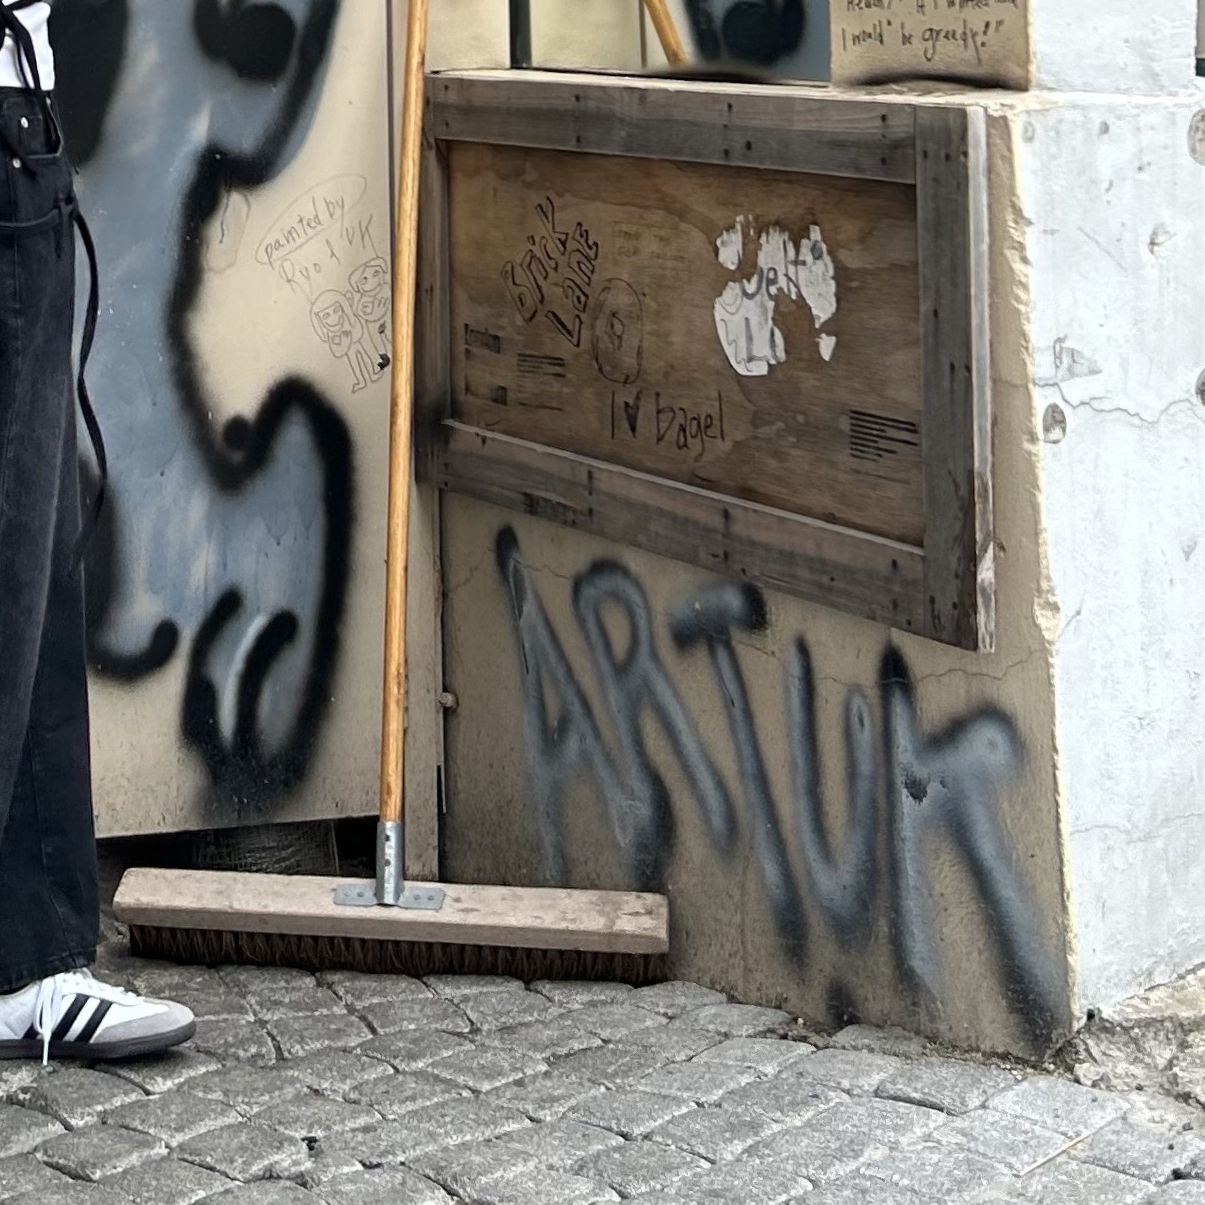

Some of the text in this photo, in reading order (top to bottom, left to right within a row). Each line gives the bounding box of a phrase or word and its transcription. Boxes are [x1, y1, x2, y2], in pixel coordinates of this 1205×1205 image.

[264, 195, 345, 270] painted by
[500, 196, 569, 325] Brick
[545, 222, 599, 348] Lane
[656, 389, 725, 463] bagel
